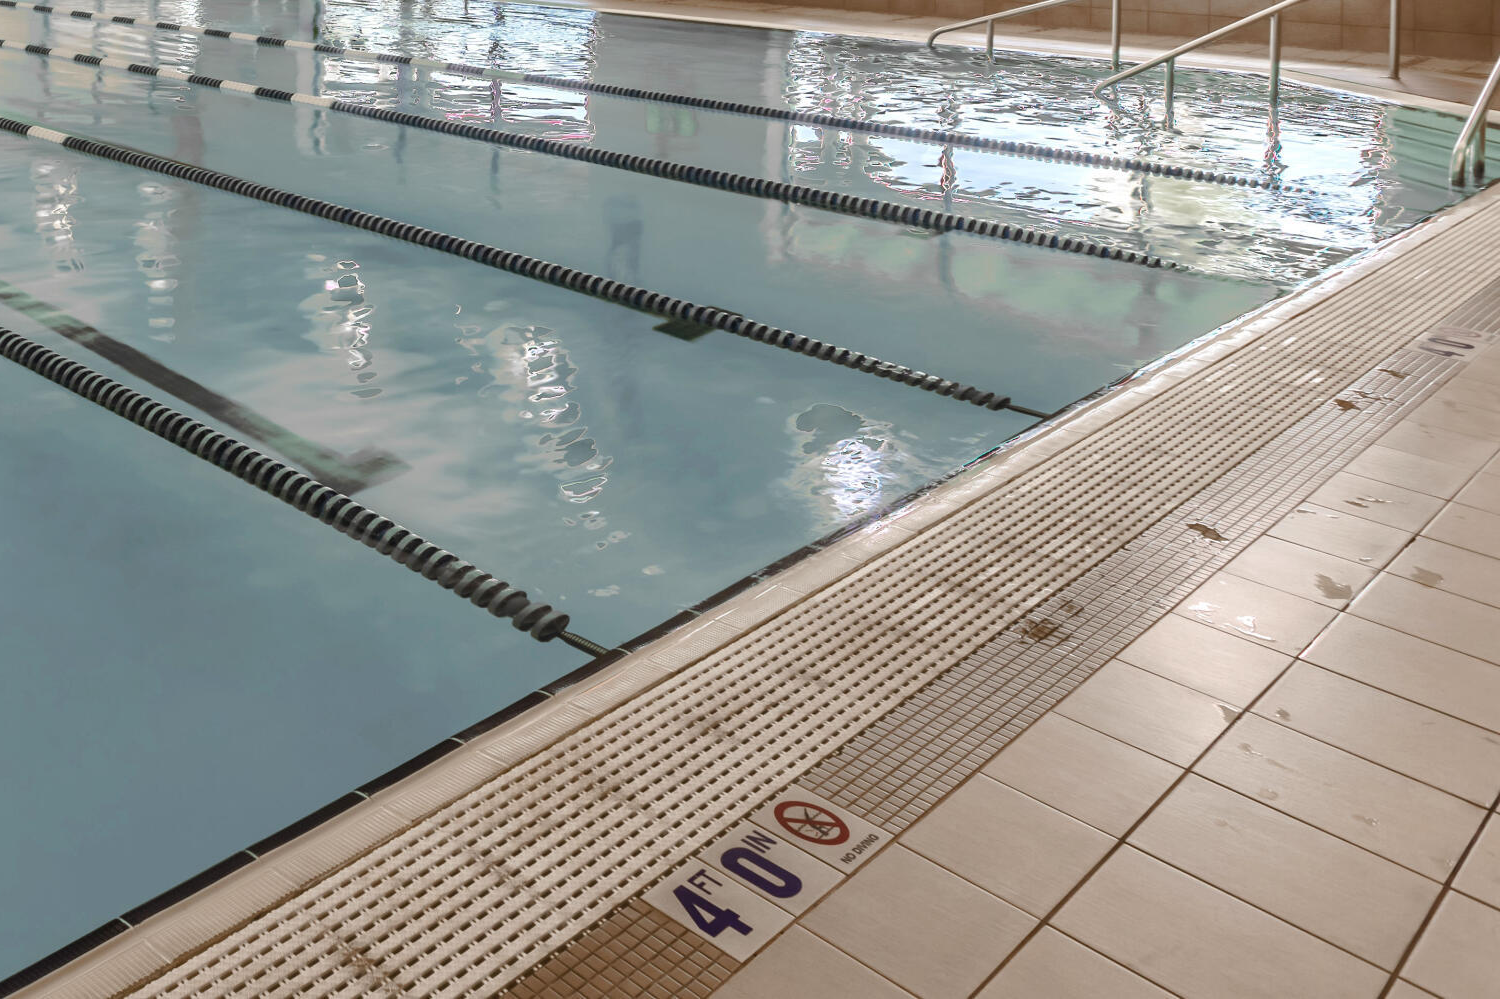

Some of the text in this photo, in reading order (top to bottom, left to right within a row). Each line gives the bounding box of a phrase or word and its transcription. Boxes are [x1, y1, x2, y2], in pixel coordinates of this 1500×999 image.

[720, 829, 802, 899] 0 IN
[840, 833, 880, 865] NO DIVING
[673, 868, 753, 938] 4 FT
